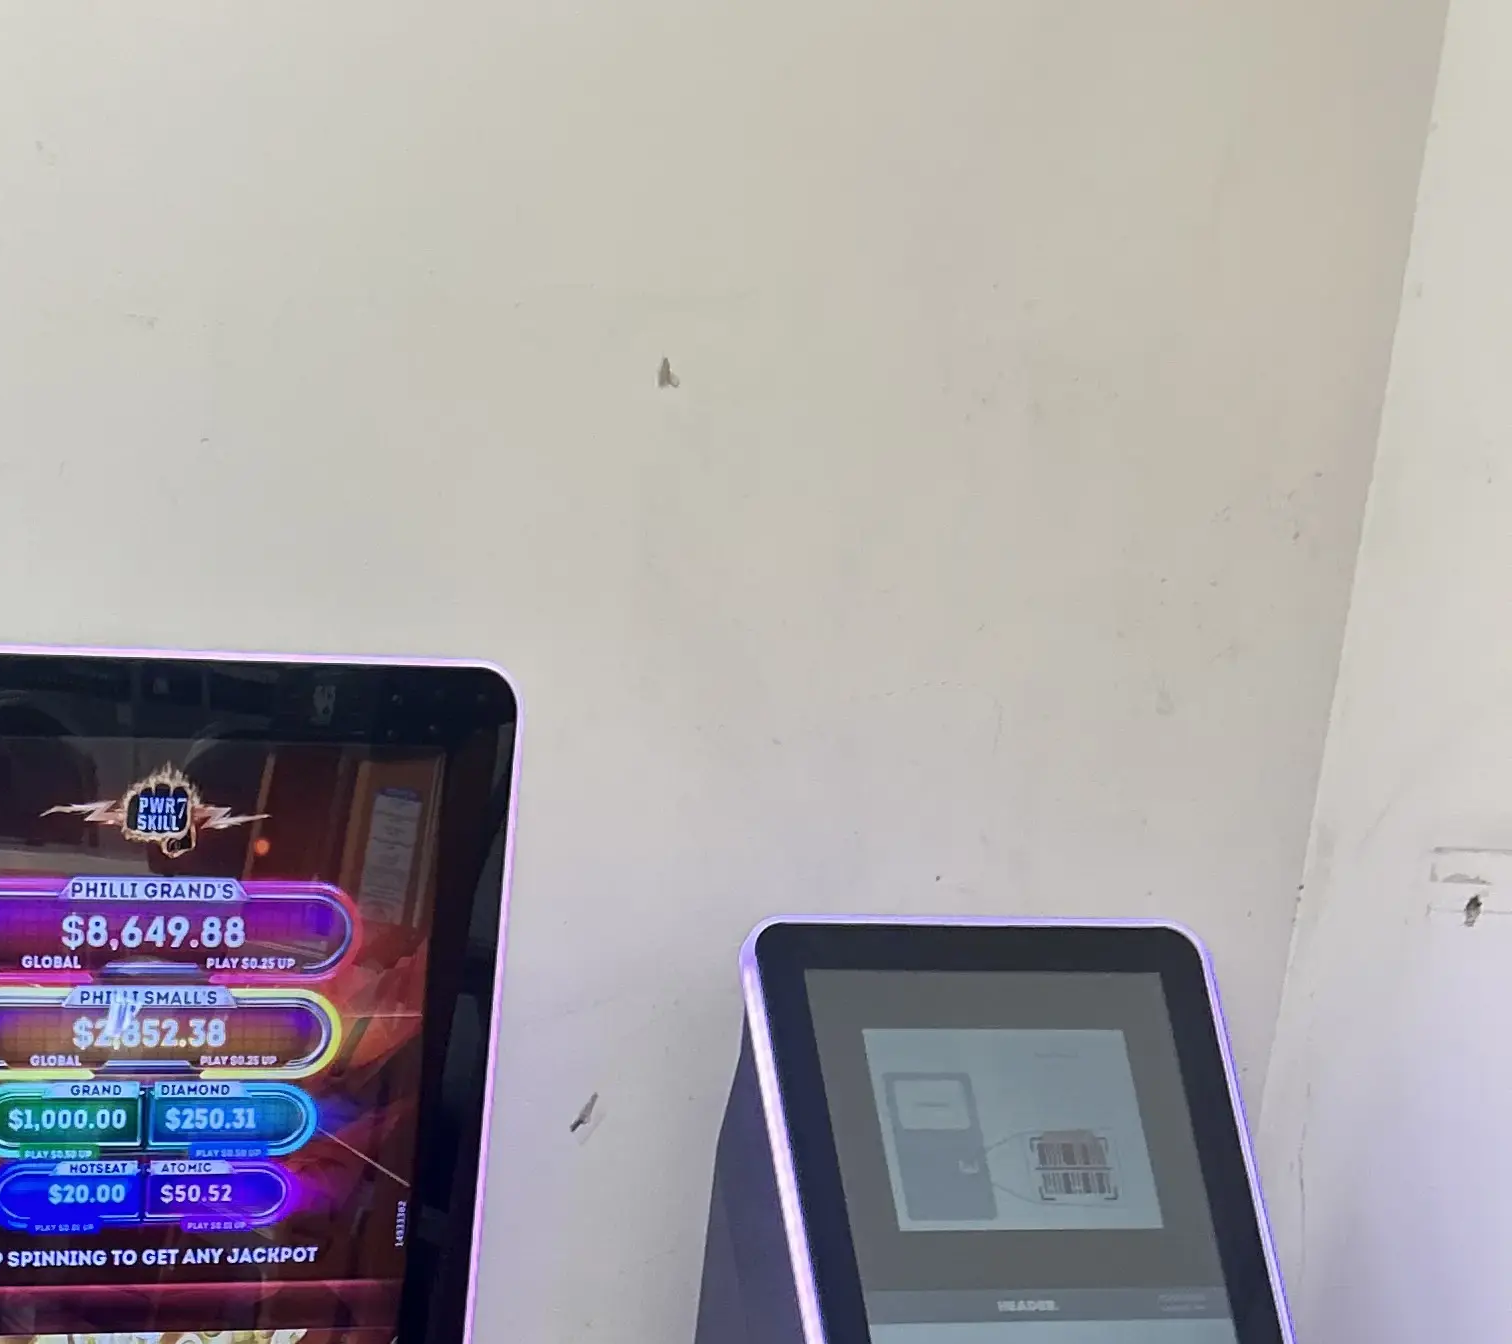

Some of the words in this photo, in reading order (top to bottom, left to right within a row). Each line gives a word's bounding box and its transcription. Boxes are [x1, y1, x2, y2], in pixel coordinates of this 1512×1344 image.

[137, 814, 179, 831] SKILL
[71, 883, 138, 897] PHILLI
[144, 883, 234, 899] GRAND'S
[61, 912, 246, 950] $8,649.88
[21, 955, 81, 969] GLOBAL
[206, 957, 239, 969] PLAY
[241, 957, 276, 969] $0.25
[277, 957, 296, 969] UP
[144, 990, 217, 1004] SMALL'S
[72, 1016, 227, 1050] $2,852.38
[29, 1055, 82, 1067] GLOBAL
[200, 1055, 228, 1065] PLAY
[262, 1055, 277, 1065] UP
[70, 1085, 122, 1096] GRAND
[161, 1084, 230, 1096] DIAMOND
[8, 1107, 127, 1132] $1,000.00
[165, 1107, 256, 1131] $250.31
[24, 1150, 48, 1159] PLAY
[78, 1150, 92, 1158] UP
[69, 1163, 128, 1174] HOTSEAT
[161, 1163, 211, 1173] ATOMIC
[48, 1184, 125, 1204] $20.00
[160, 1184, 232, 1204] $50.52
[7, 1250, 107, 1267] SPINNING
[111, 1250, 138, 1265] TO
[141, 1249, 179, 1265] GET
[182, 1248, 224, 1264] ANY
[227, 1246, 318, 1263] JACKPOT
